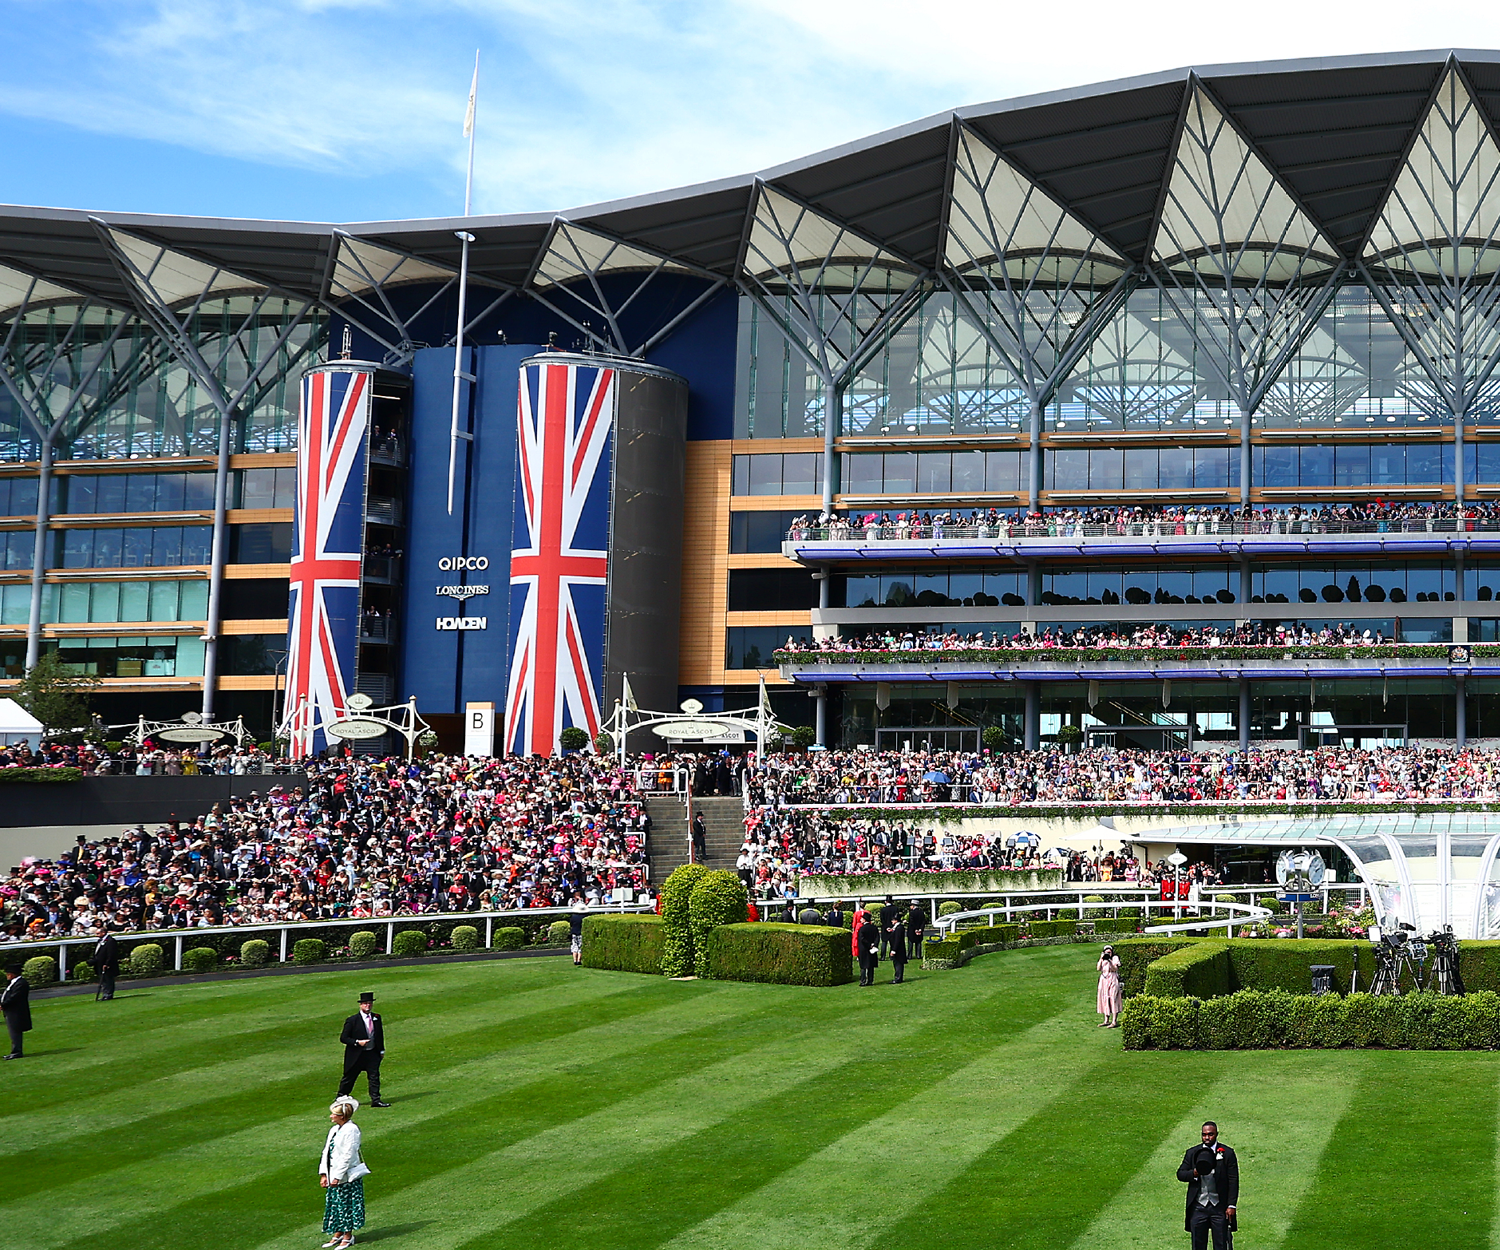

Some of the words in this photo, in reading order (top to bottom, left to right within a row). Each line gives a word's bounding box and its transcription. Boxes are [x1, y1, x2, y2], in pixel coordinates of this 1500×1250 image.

[438, 556, 489, 571] QIPCO
[435, 585, 490, 595] LONGINES
[436, 617, 487, 630] HOWDEN
[473, 712, 484, 729] B
